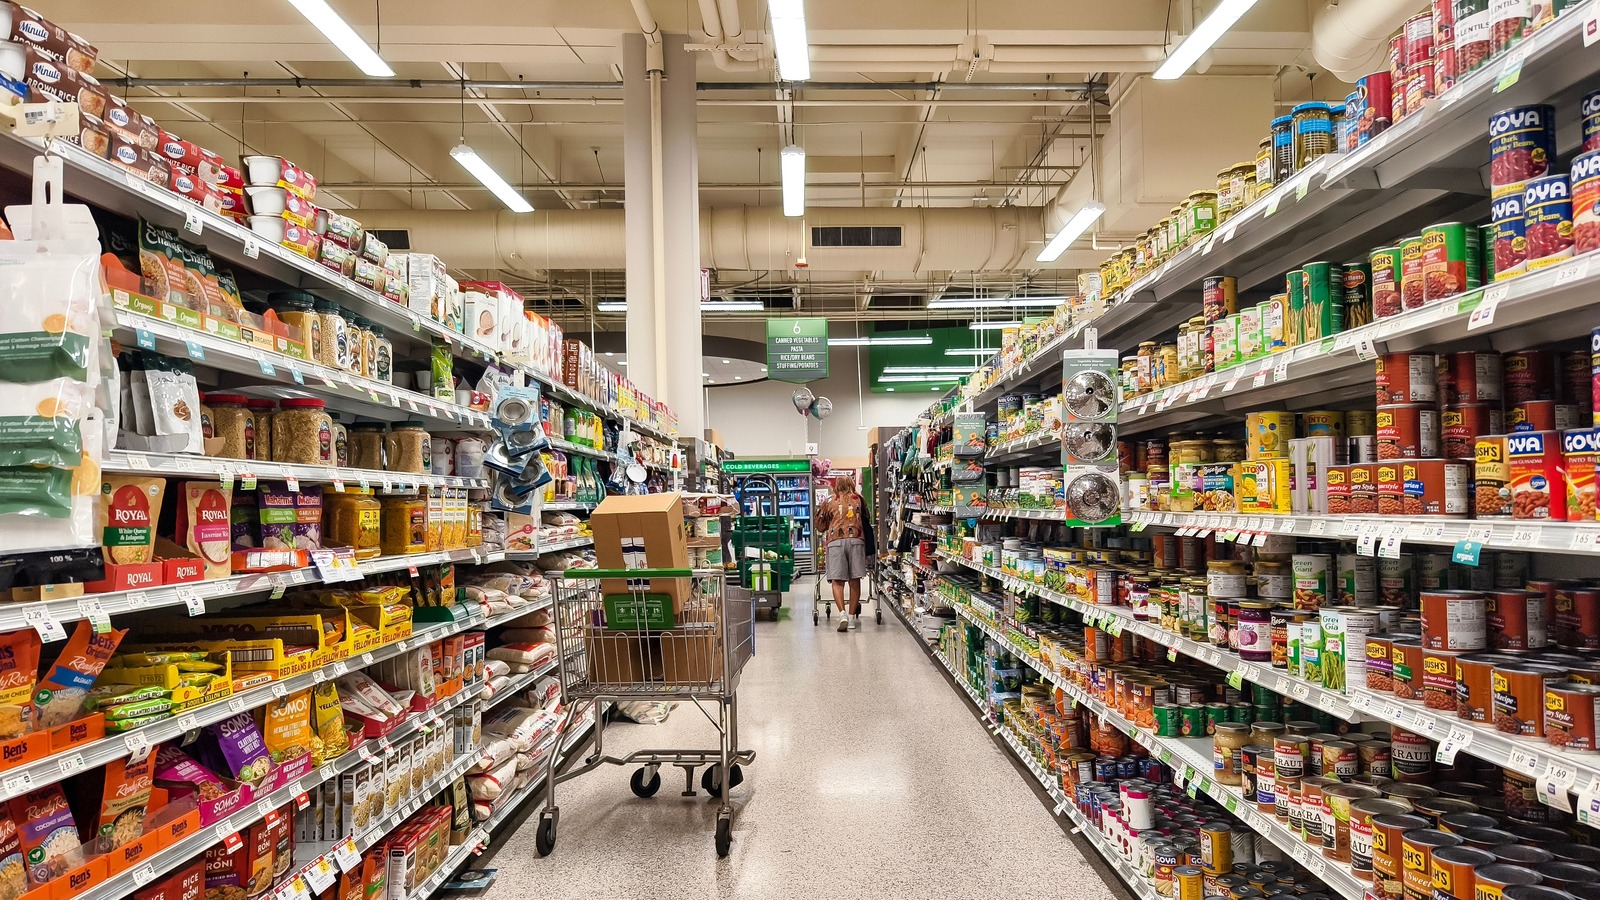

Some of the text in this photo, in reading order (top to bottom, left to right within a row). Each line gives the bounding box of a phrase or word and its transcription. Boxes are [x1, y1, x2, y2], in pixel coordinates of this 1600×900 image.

[19, 20, 49, 40] Minute
[1460, 21, 1489, 36] LENTILS
[47, 50, 64, 62] RICE
[32, 62, 61, 82] Minute
[26, 78, 76, 102] BROWN RICE
[110, 108, 129, 125] Minute
[1489, 111, 1539, 136] GOYA
[1501, 136, 1518, 145] Dark
[1513, 140, 1534, 148] Beans
[164, 142, 185, 158] Minute
[182, 164, 196, 175] RICE
[1571, 155, 1600, 182] OYA
[1525, 181, 1567, 208] OYA
[1529, 209, 1543, 217] Dark
[1539, 213, 1561, 223] Beans
[1498, 229, 1515, 238] Beans
[1560, 268, 1578, 280] 3.59
[793, 321, 801, 335] 6
[1508, 437, 1540, 453] OYA
[1476, 464, 1501, 476] rganic
[115, 509, 228, 524] ROYAL ROYAL
[1392, 526, 1405, 534] 2.29
[1515, 532, 1589, 544] 2.05 1.65
[50, 554, 73, 563] 100 %
[1293, 559, 1312, 567] Green
[176, 566, 198, 579] ROYAL
[127, 572, 153, 587] ROYAL
[26, 611, 42, 621] 2.29
[382, 628, 411, 643] YELLOW RICE
[354, 635, 381, 651] YELLOW RICE
[340, 648, 349, 659] RICE
[280, 655, 321, 678] RED BEANS & RICE
[129, 703, 171, 717] CILANTRO LIME RICE
[1414, 717, 1425, 727] 2.29
[1555, 711, 1571, 722] Style
[70, 722, 87, 734] Ben's
[127, 738, 140, 747] 2.05
[1451, 731, 1466, 742] 2.29
[3, 741, 28, 760] Ben's
[1511, 752, 1524, 764] 1.69
[61, 762, 73, 772] 2.87
[1550, 767, 1566, 778] 1.69
[7, 781, 18, 789] 2.87
[213, 793, 239, 814] SOMOS
[35, 818, 57, 832] COCONUT
[171, 820, 187, 836] Ben's
[125, 842, 143, 860] Ben's
[258, 841, 271, 853] RONI
[206, 859, 233, 871] RONI
[1156, 856, 1176, 864] GOYA
[70, 868, 91, 888] Ben's
[183, 873, 198, 888] RICE
[1407, 872, 1432, 888] Sweet
[183, 886, 198, 900] RONI
